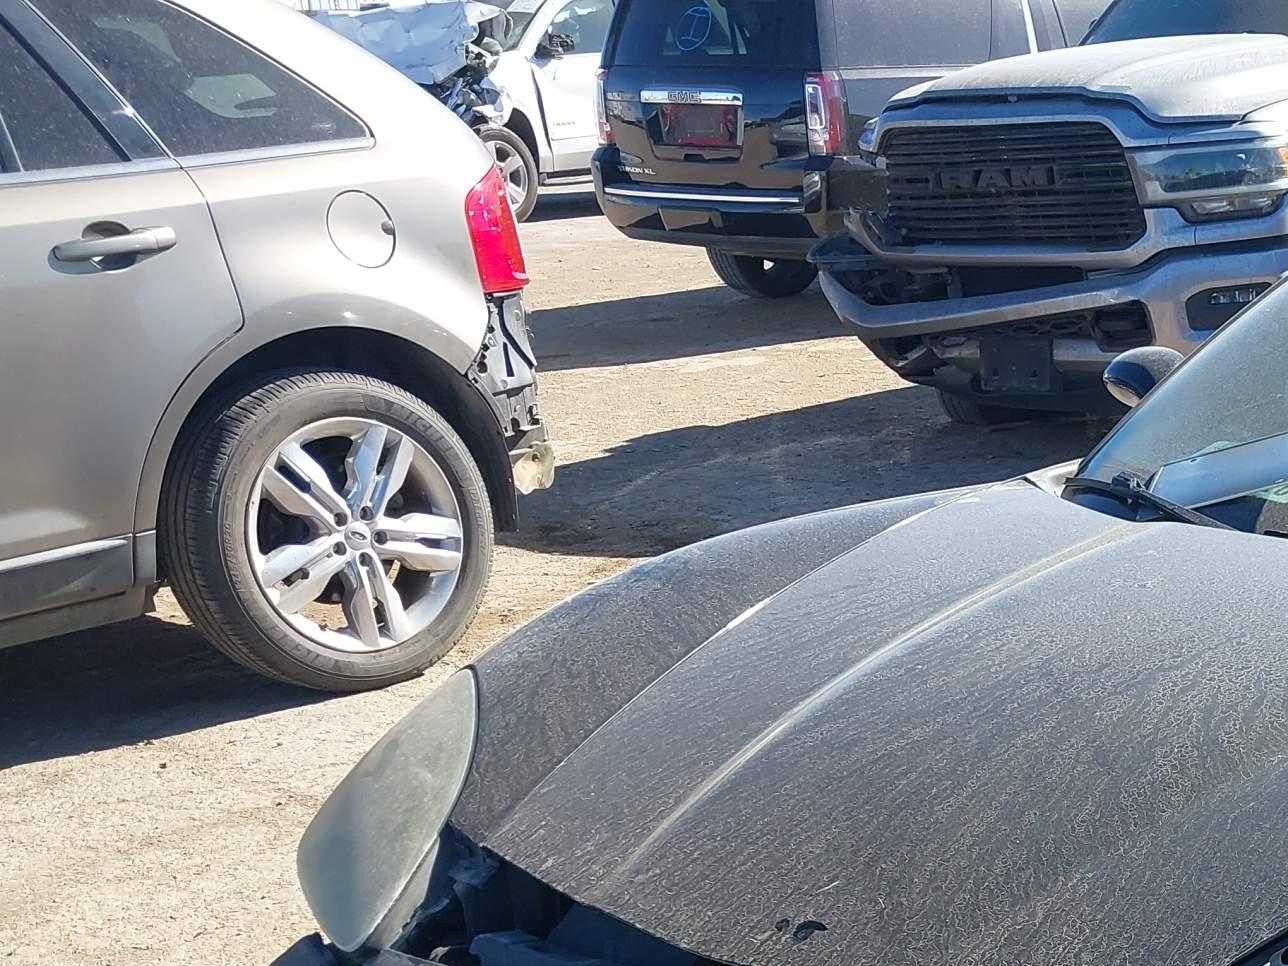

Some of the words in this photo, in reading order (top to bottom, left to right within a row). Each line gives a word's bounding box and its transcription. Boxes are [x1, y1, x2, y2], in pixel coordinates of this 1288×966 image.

[667, 91, 702, 103] GMC
[643, 167, 657, 176] XL
[936, 160, 1052, 190] RAM
